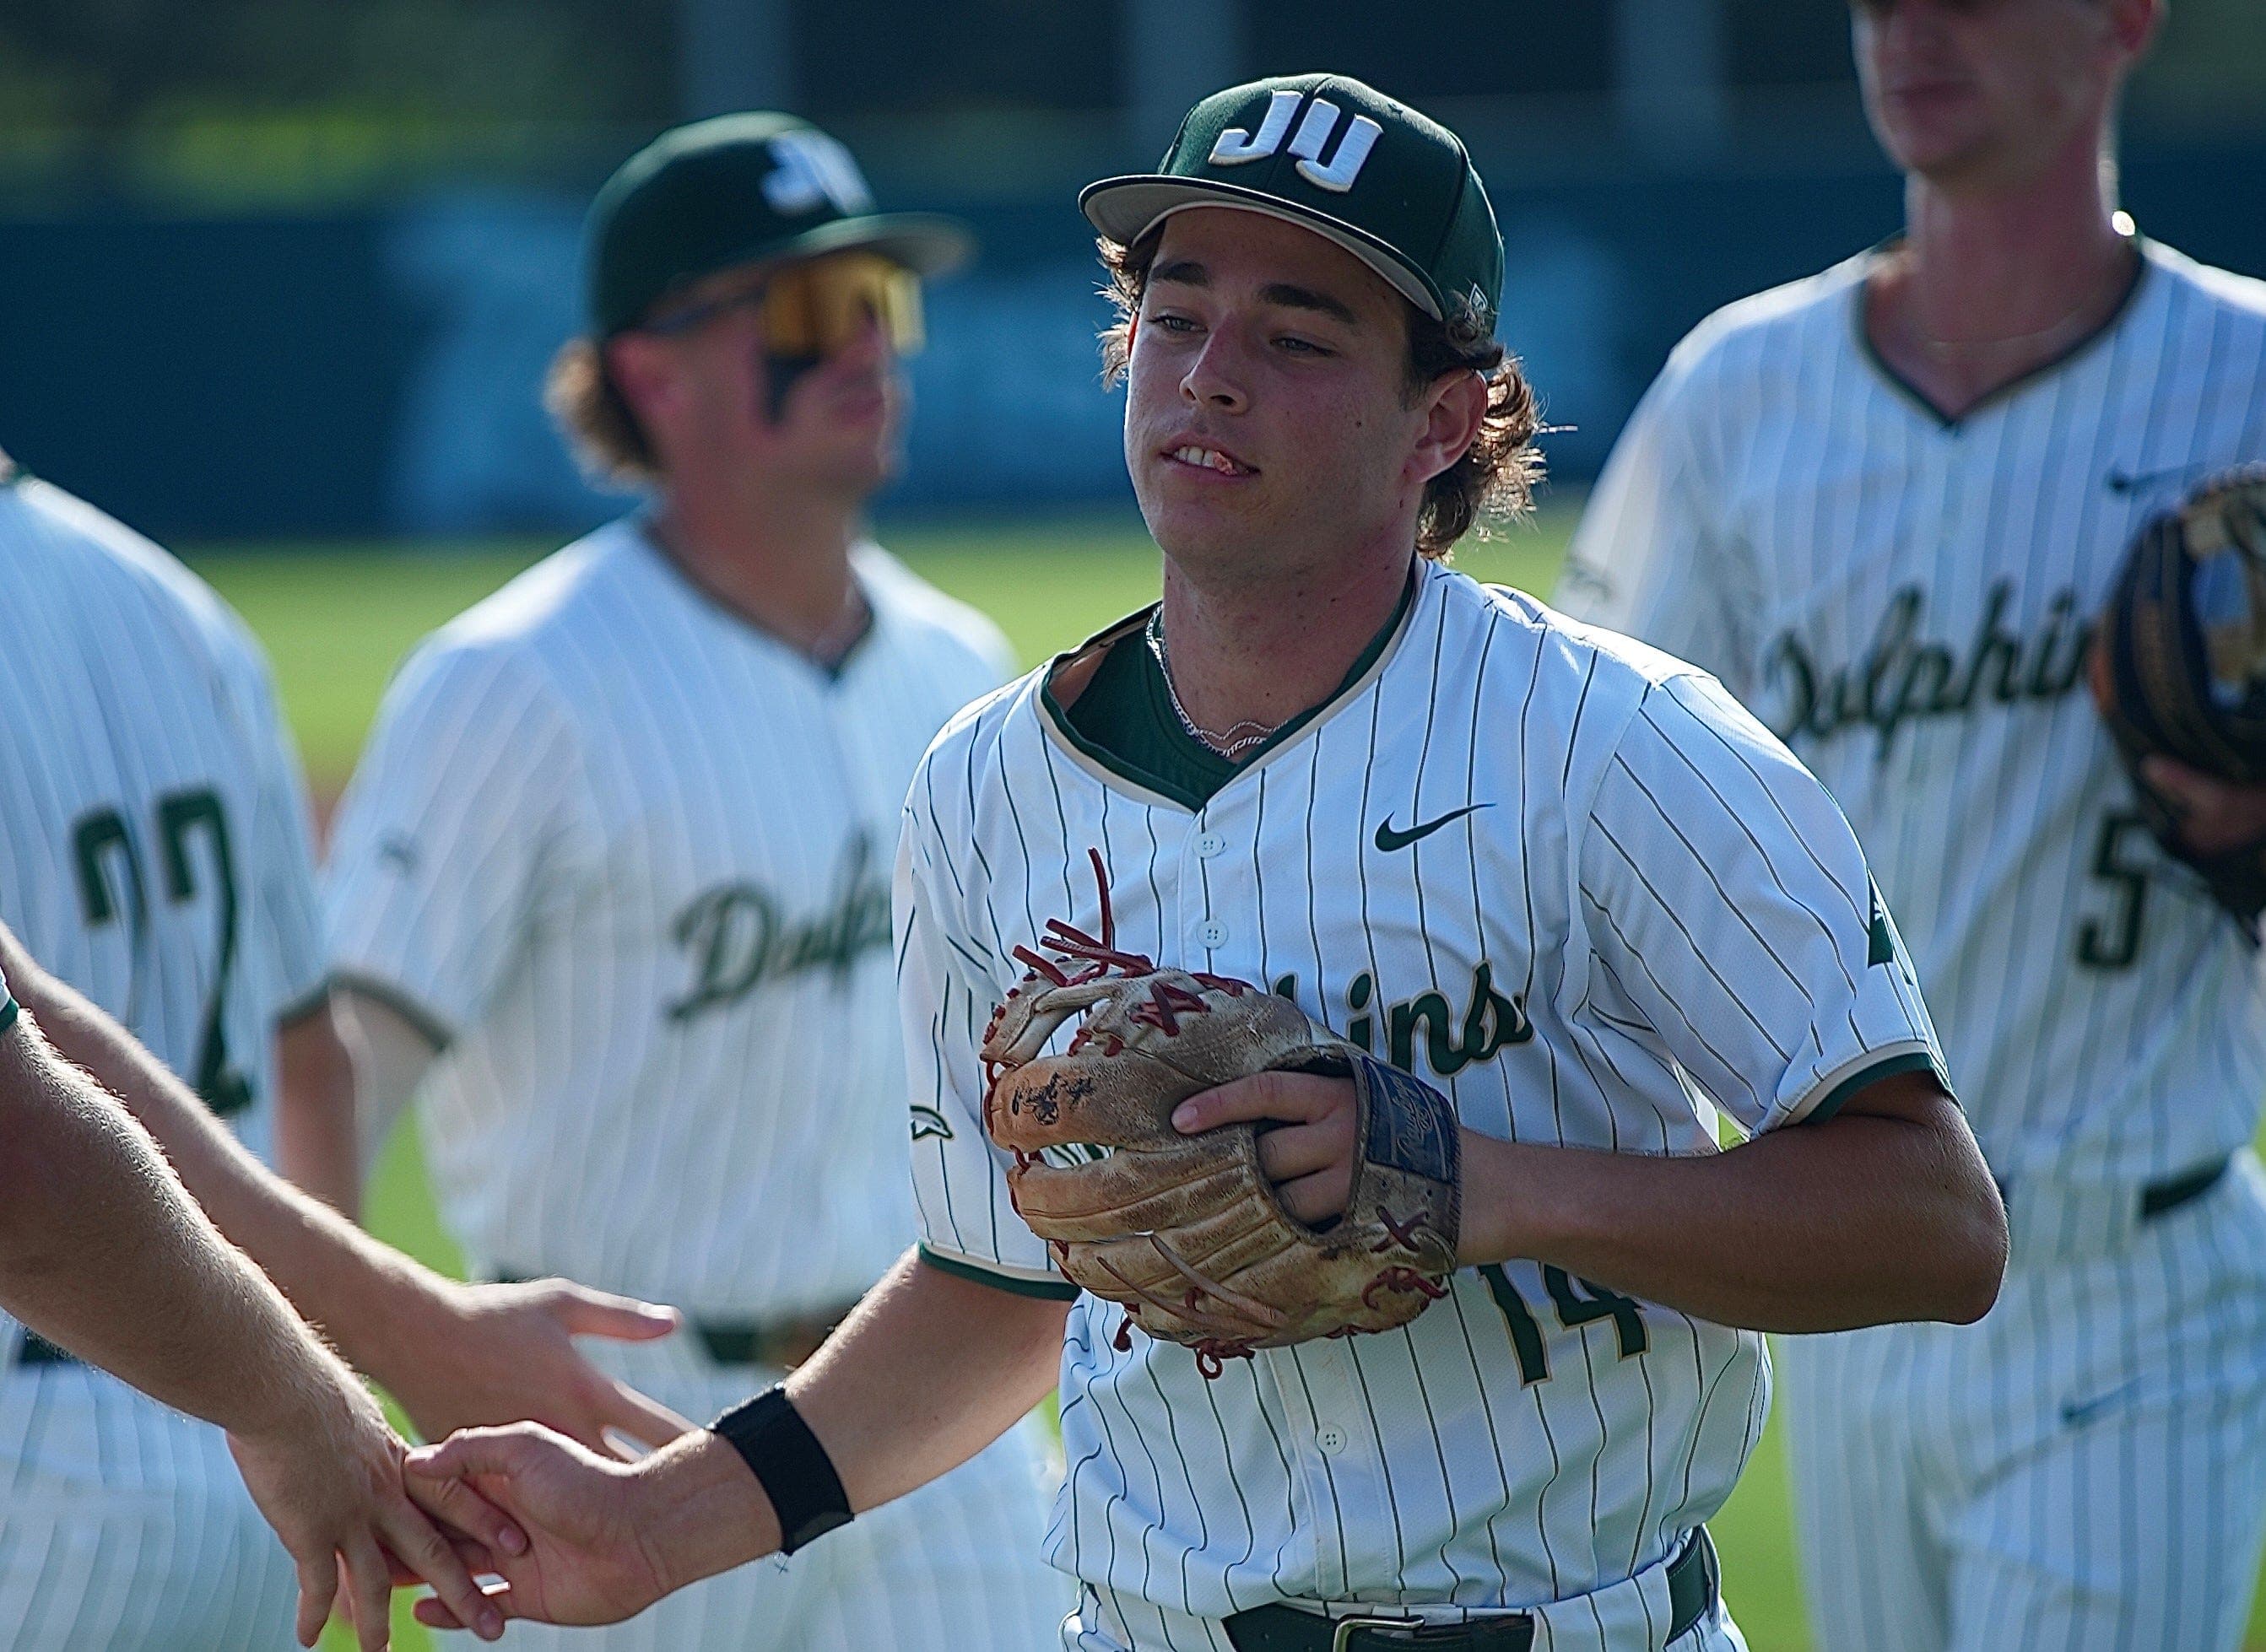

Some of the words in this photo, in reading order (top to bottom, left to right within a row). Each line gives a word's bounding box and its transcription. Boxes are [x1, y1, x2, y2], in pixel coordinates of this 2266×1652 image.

[1208, 89, 1384, 193] JU
[1273, 957, 1536, 1077] ins
[1477, 1261, 1652, 1390] 14
